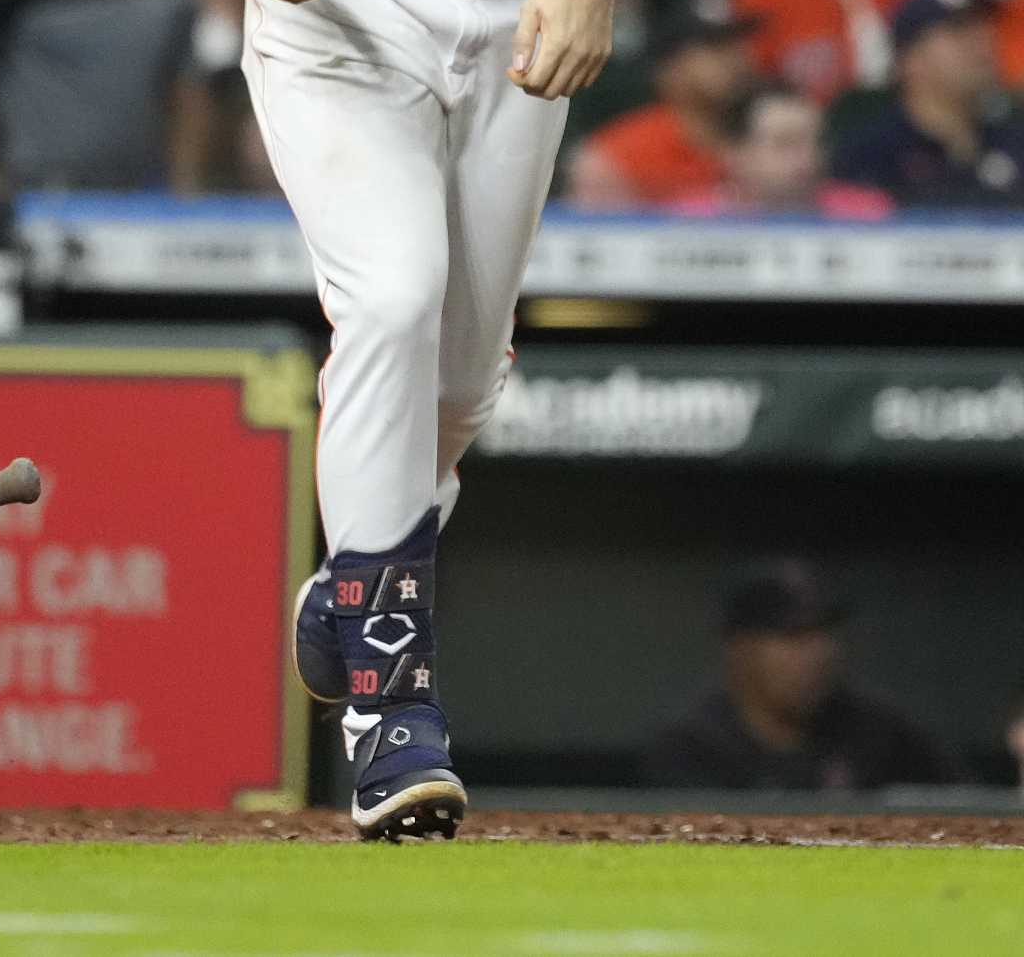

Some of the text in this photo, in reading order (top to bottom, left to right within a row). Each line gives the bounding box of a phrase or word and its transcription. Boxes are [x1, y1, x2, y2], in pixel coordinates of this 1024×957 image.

[29, 543, 172, 619] CAR
[337, 580, 364, 607] 30
[351, 669, 379, 695] 30
